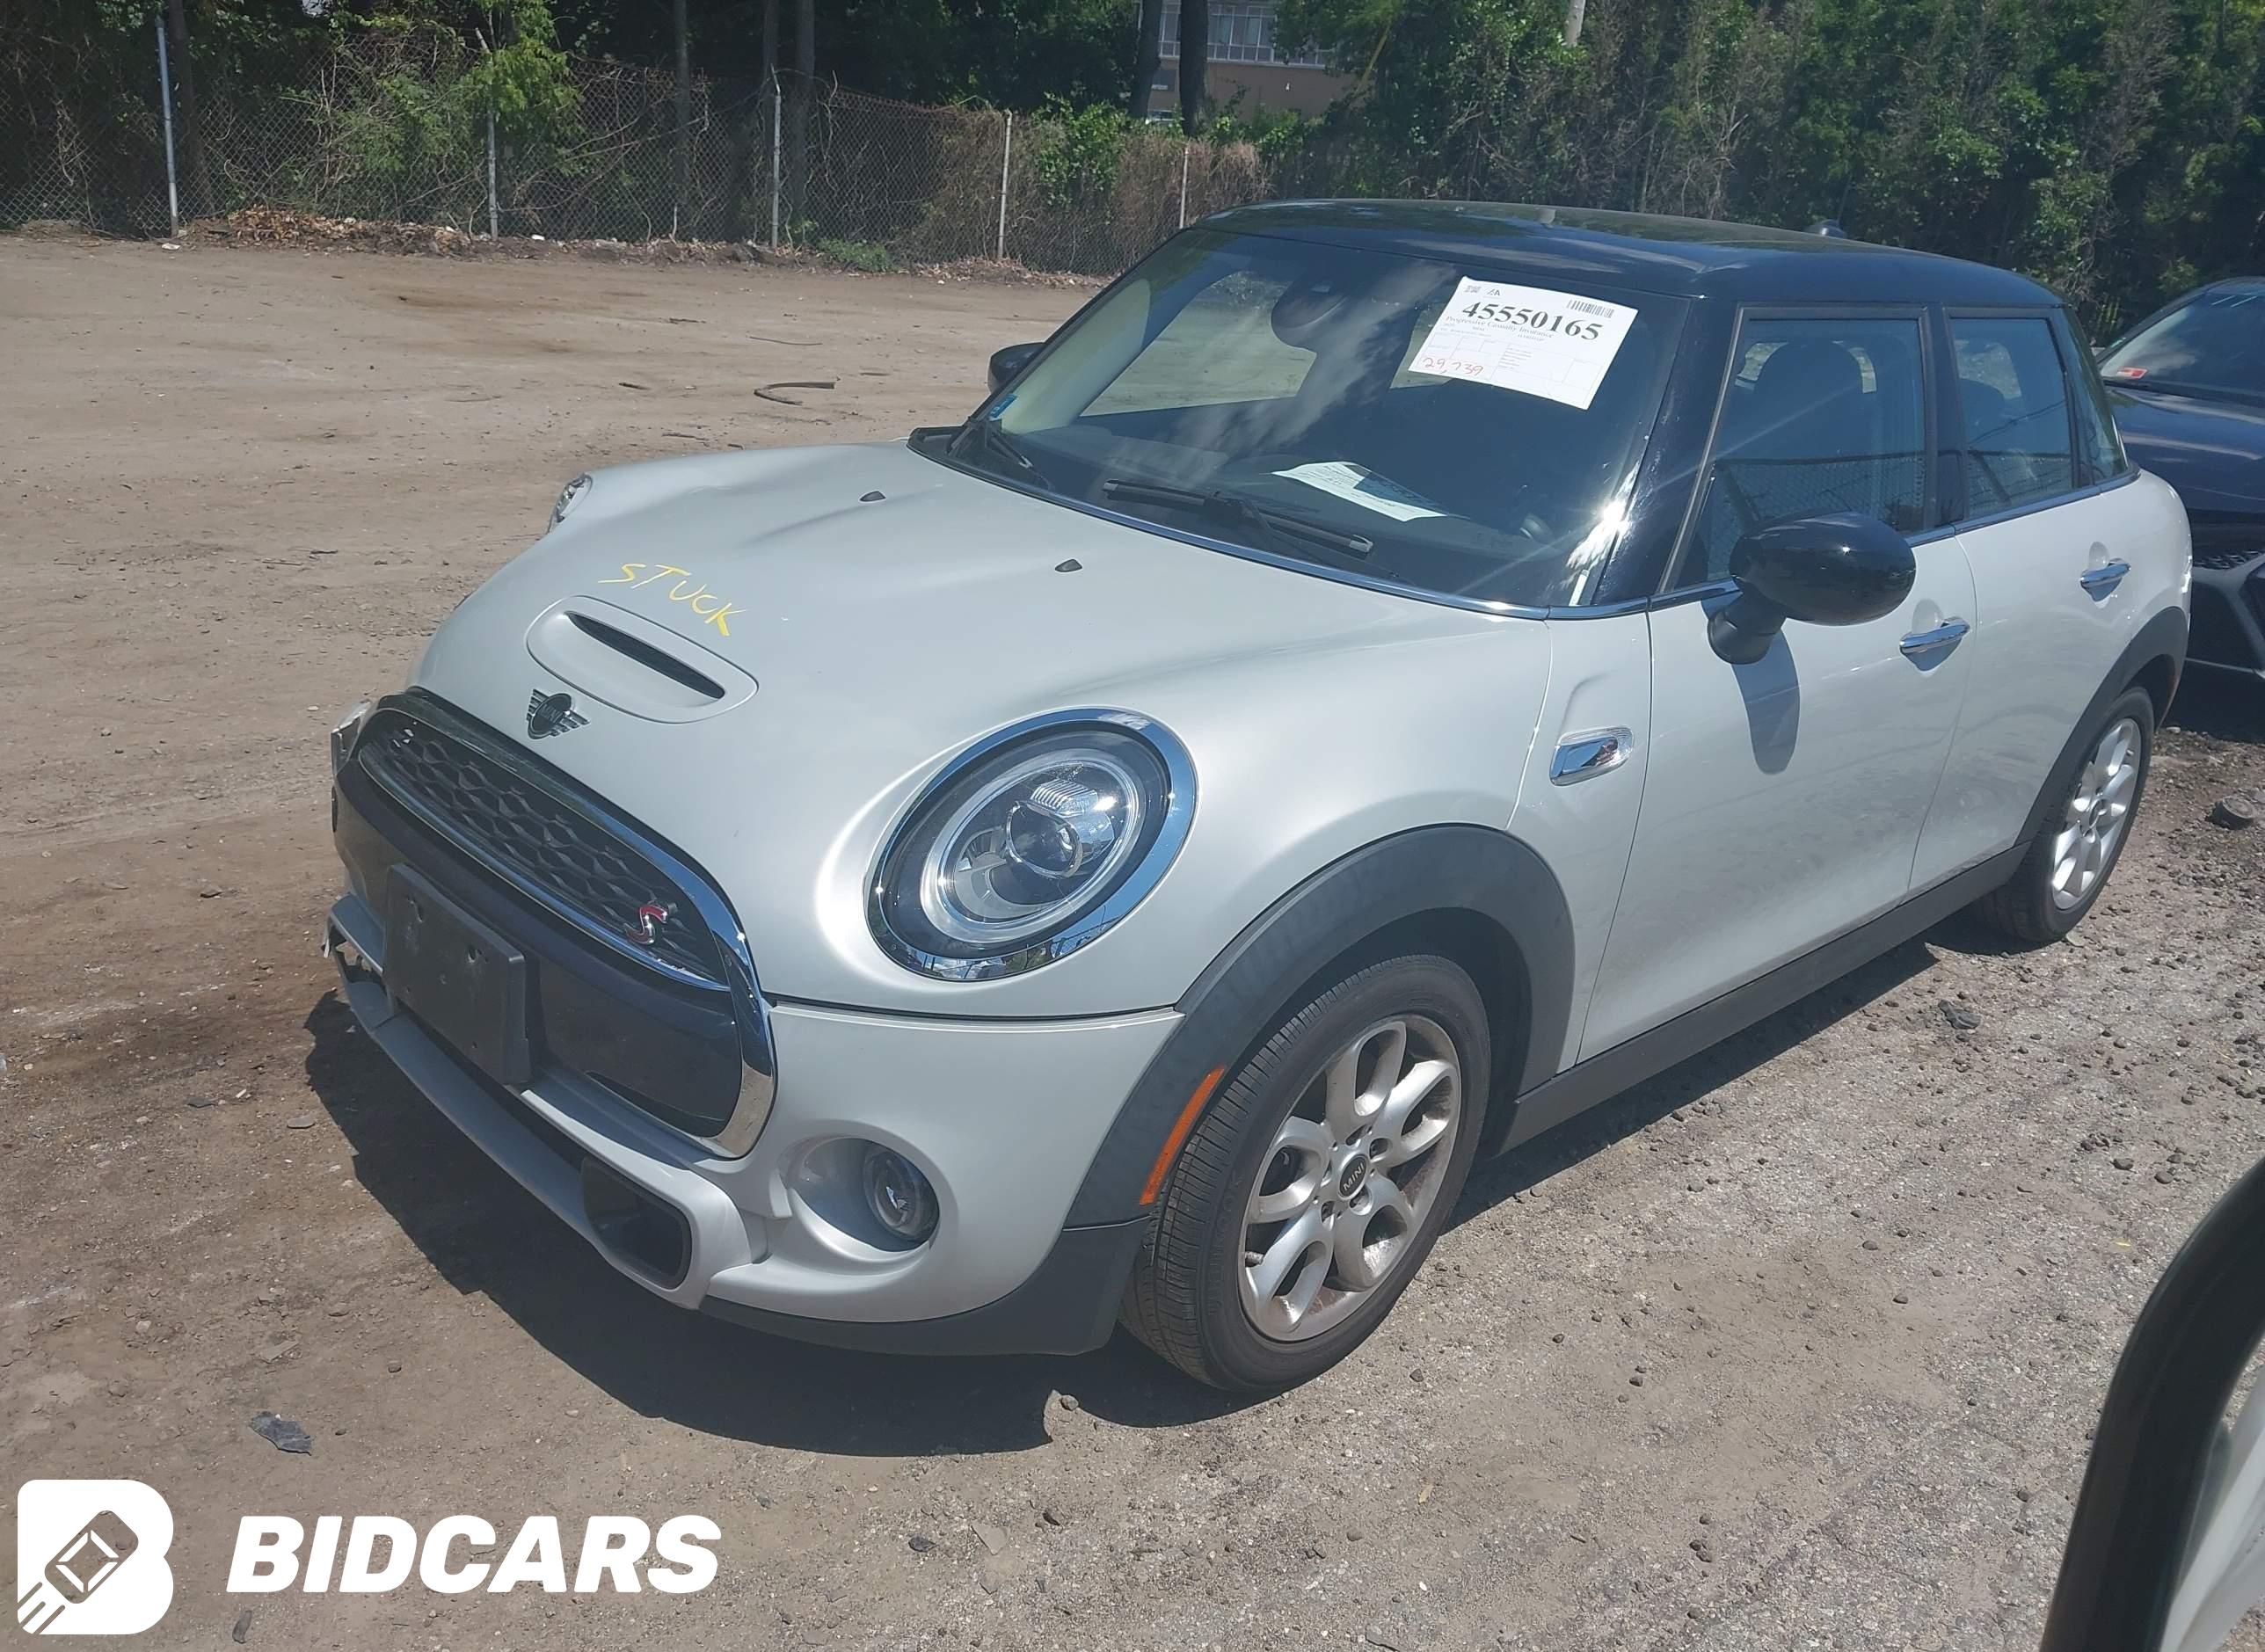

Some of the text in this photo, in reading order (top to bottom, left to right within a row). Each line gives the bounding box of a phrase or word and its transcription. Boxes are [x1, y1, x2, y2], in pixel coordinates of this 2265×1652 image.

[1462, 302, 1604, 340] 45550165
[598, 563, 748, 637] STUCK
[1343, 1162, 1366, 1191] MINI
